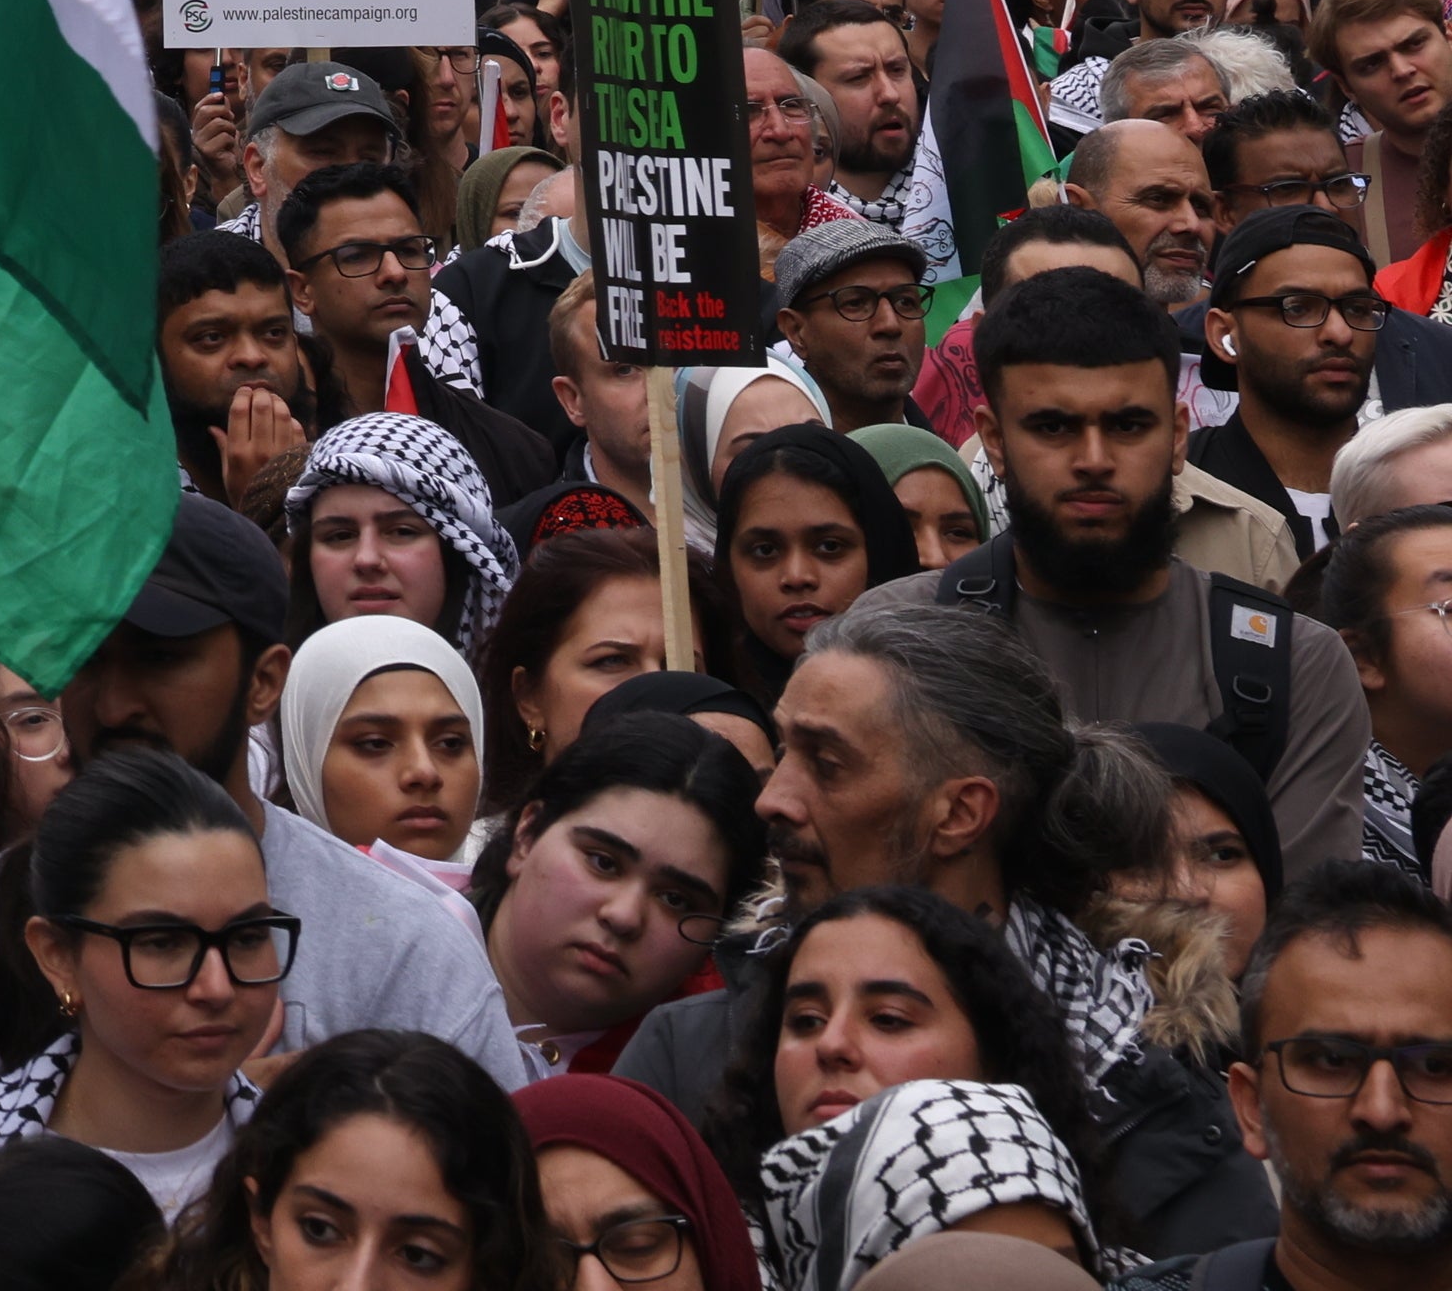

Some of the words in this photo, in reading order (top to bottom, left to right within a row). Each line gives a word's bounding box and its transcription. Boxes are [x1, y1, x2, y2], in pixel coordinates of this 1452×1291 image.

[223, 5, 418, 24] www.palestinecampaign.org
[652, 23, 698, 84] TO
[628, 87, 685, 149] SEA
[651, 224, 692, 283] BE
[697, 292, 725, 318] the
